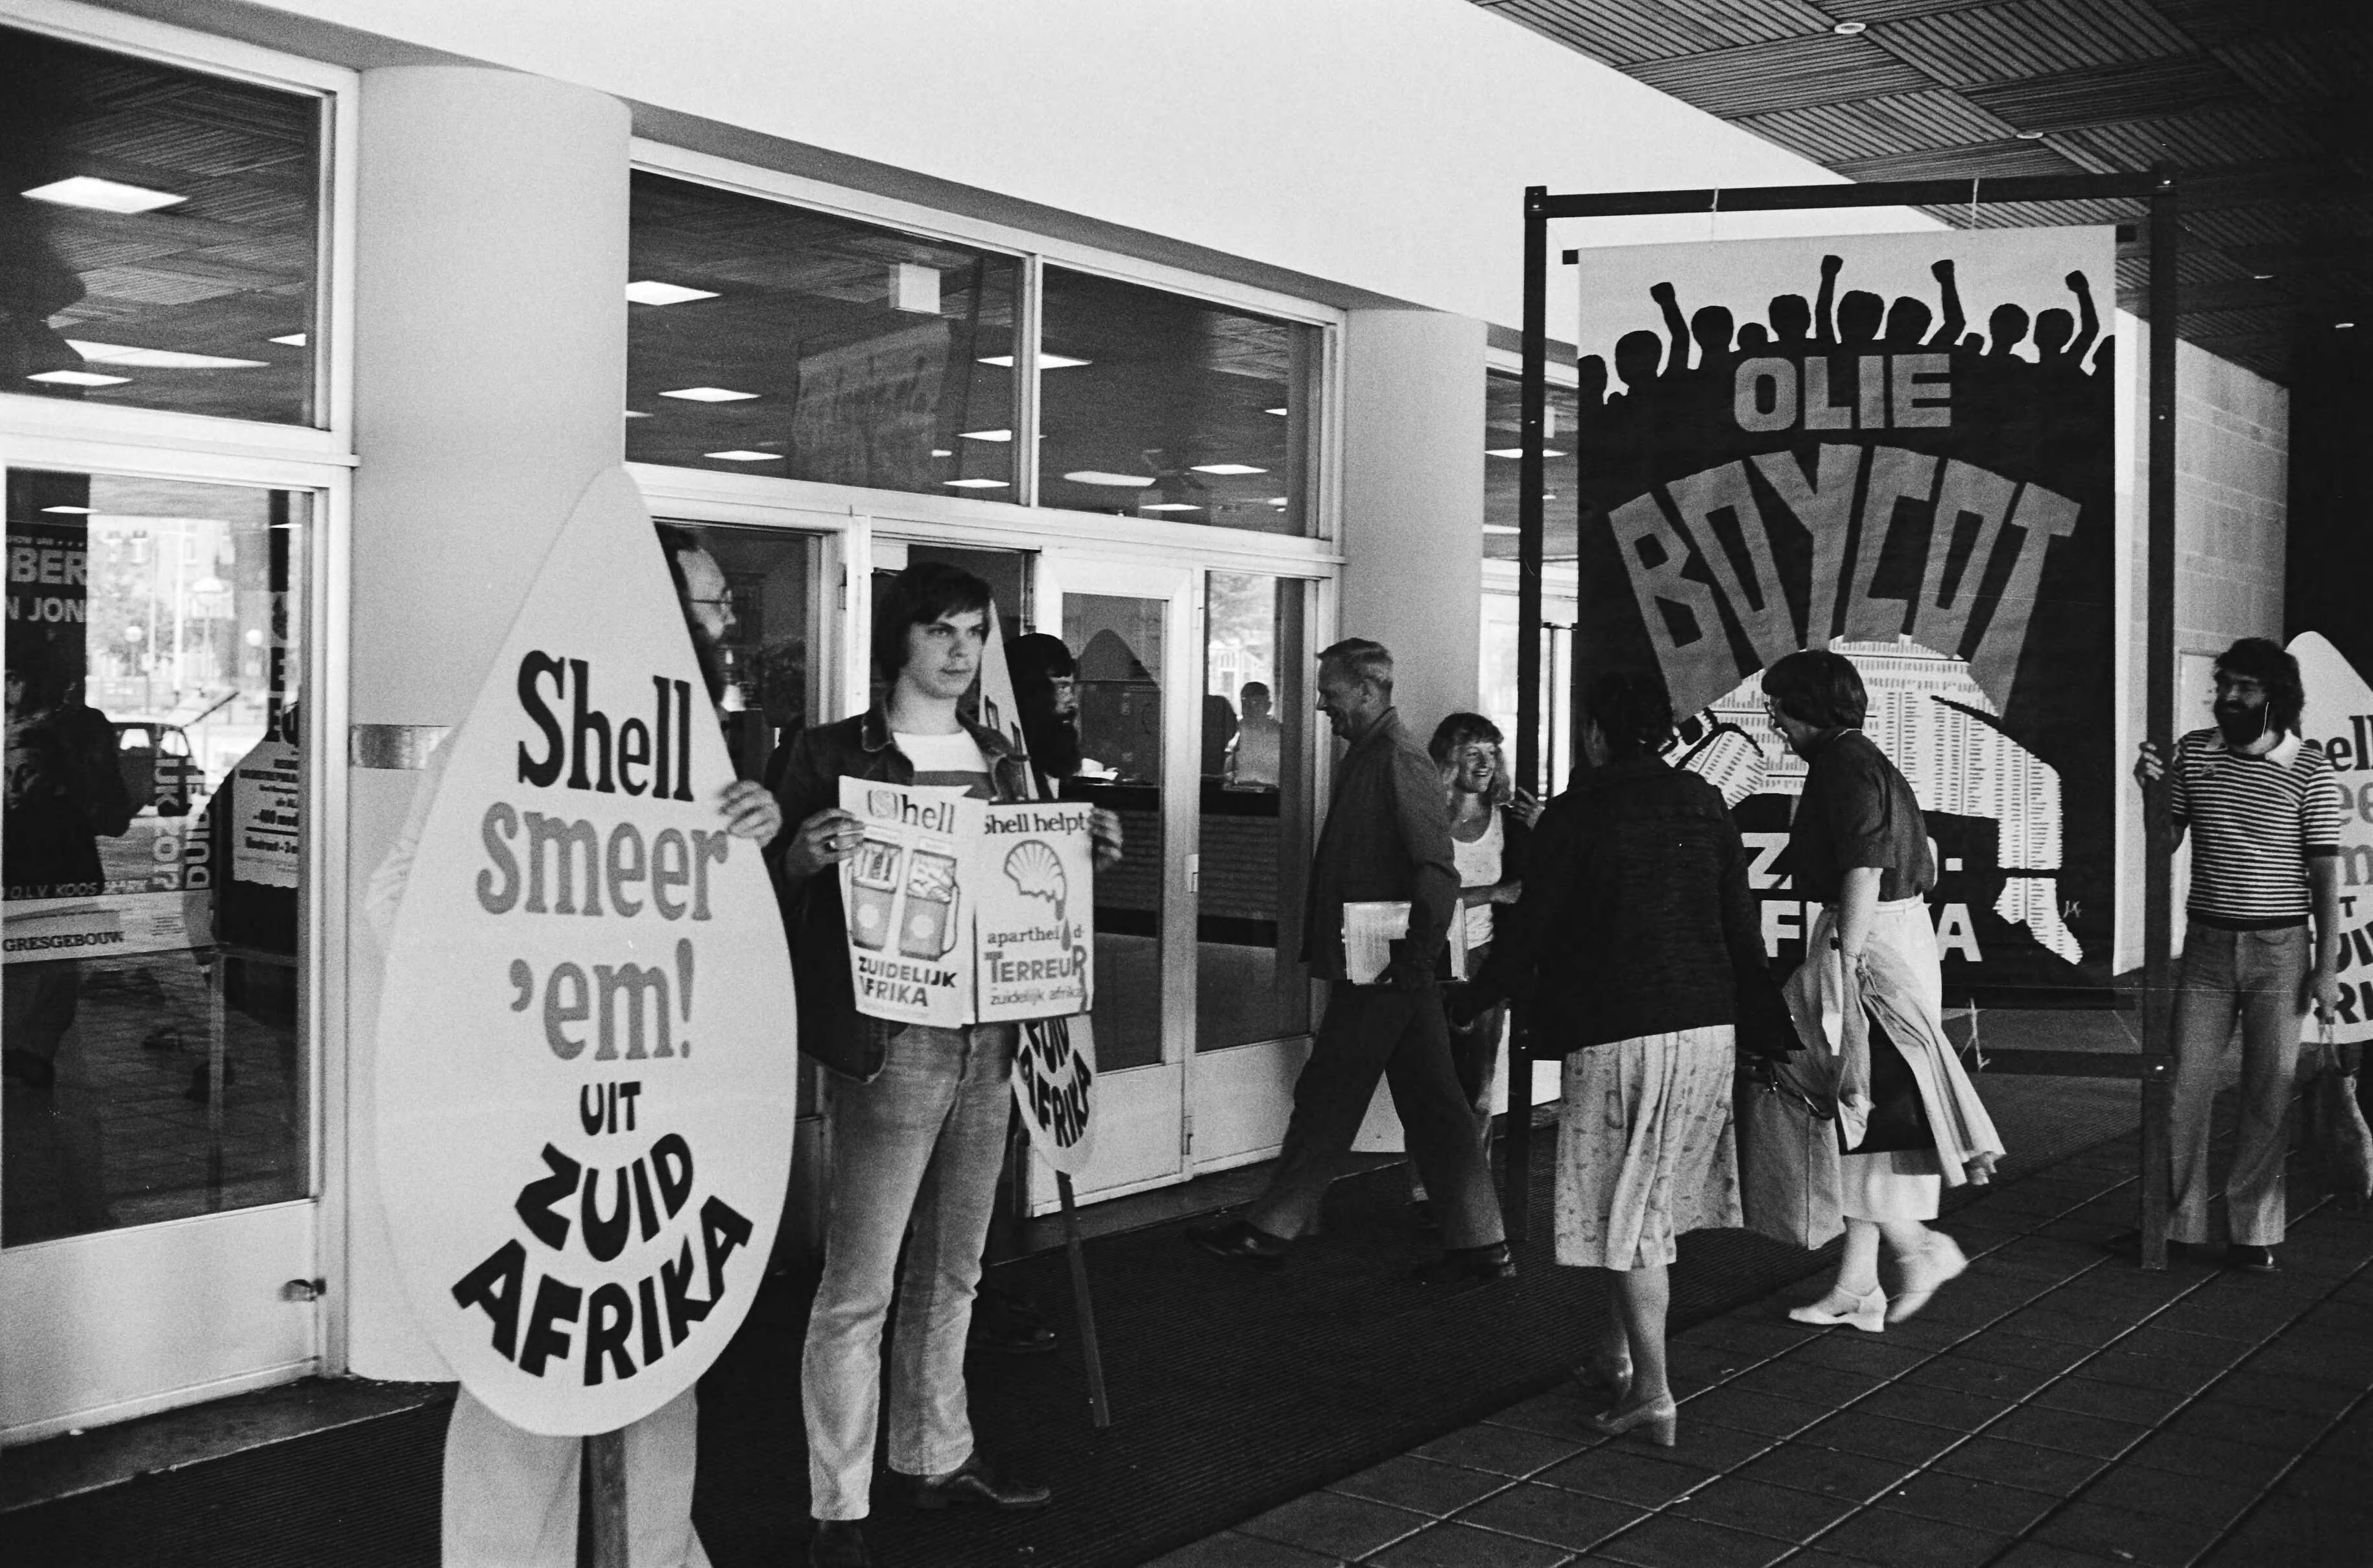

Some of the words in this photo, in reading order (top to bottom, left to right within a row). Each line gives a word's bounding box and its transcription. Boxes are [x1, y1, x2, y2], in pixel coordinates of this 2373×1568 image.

[1733, 353, 1951, 433] OLIE
[6, 547, 87, 586] BER
[1608, 443, 2082, 722] BOYCOT
[518, 650, 695, 802] Shell
[476, 802, 728, 921] smeer
[1034, 812, 1085, 835] helpt
[509, 938, 695, 1060] 'em!
[859, 956, 958, 988] ZUIDELIJK
[984, 945, 1086, 983] TERREUR
[580, 1081, 641, 1136] UIT
[1020, 1045, 1092, 1148] AFRIKA
[514, 1133, 694, 1262] ZUID
[451, 1194, 754, 1386] AFRIKA
